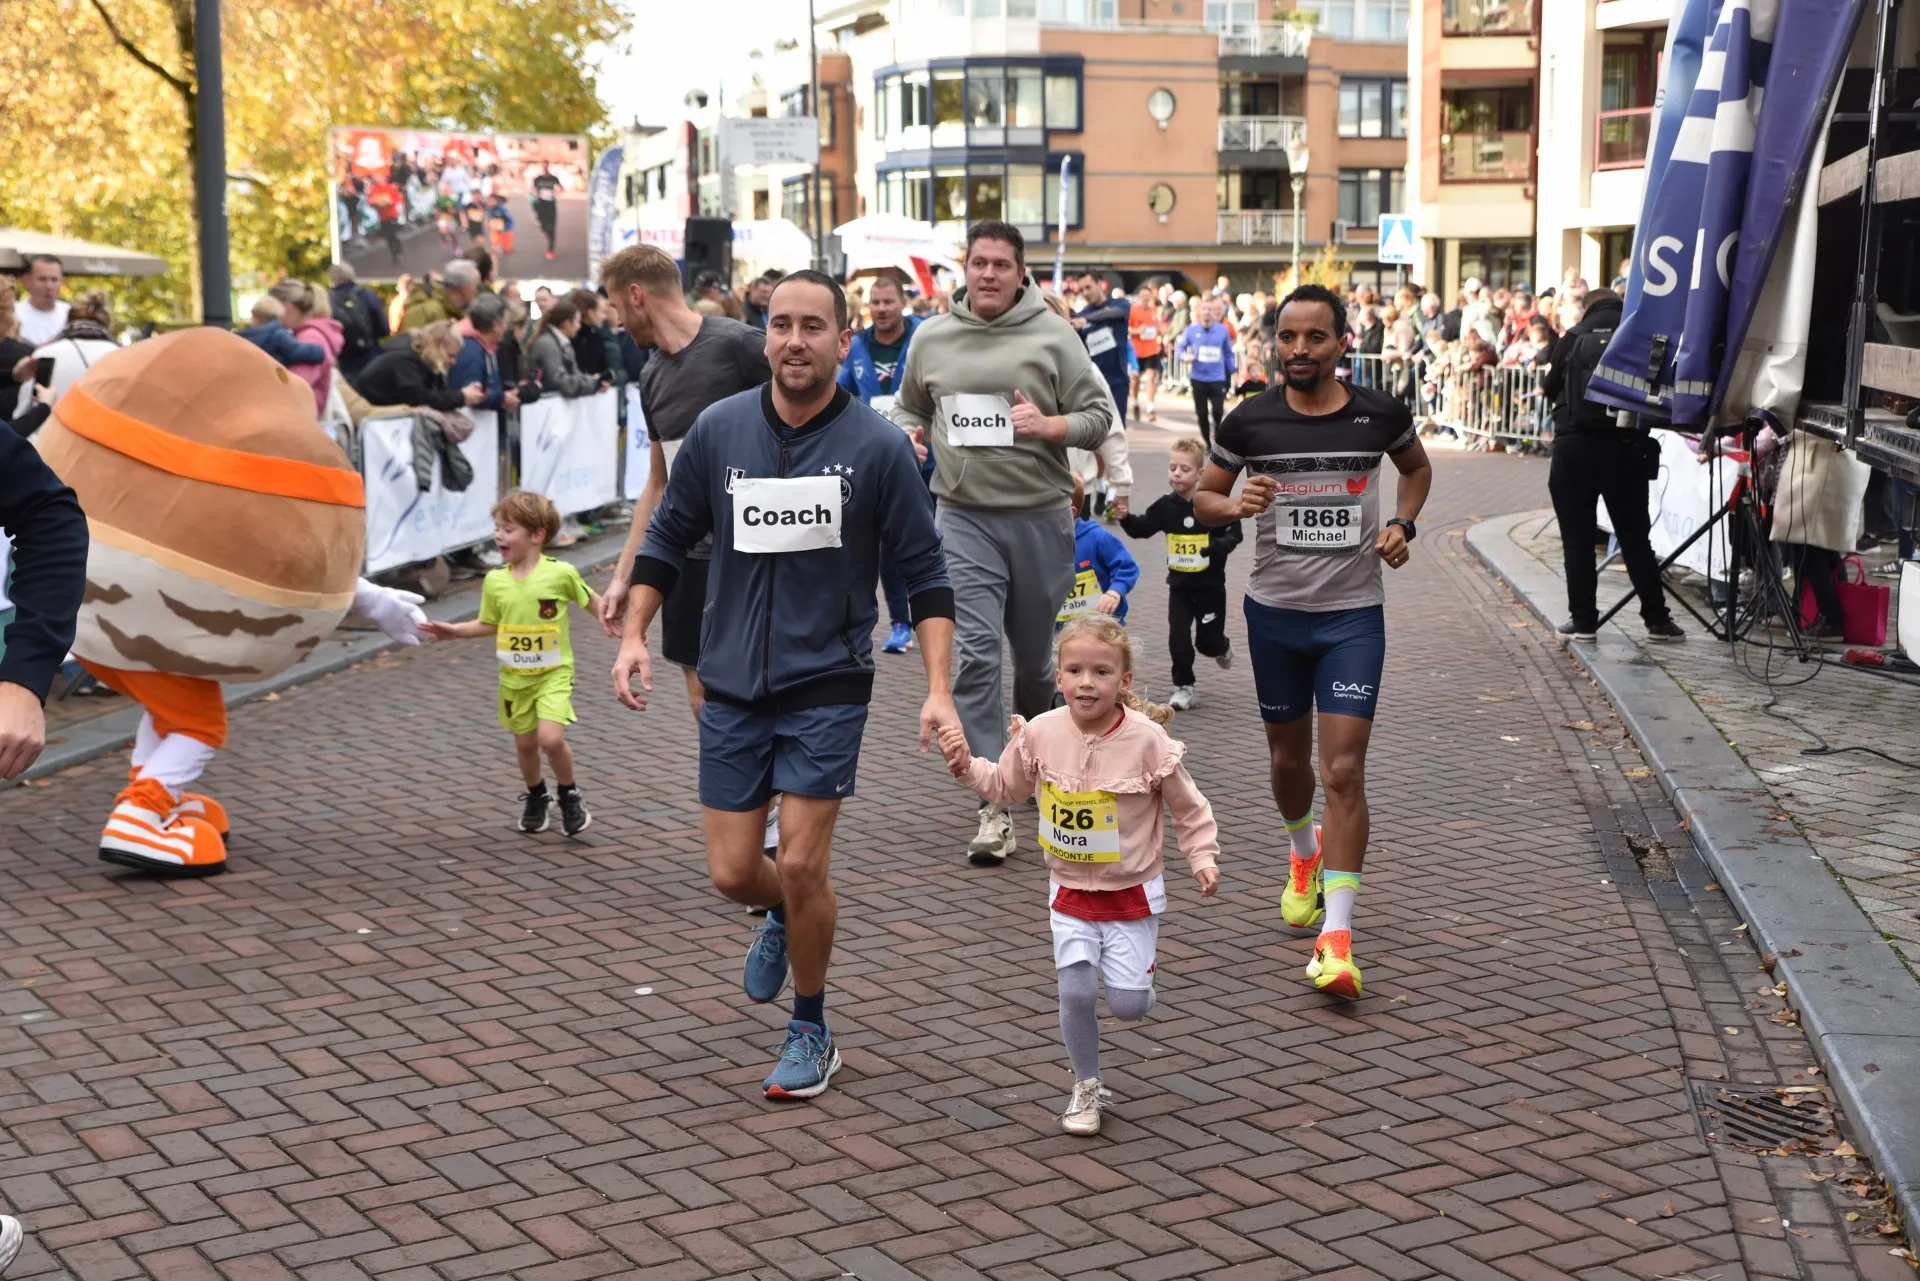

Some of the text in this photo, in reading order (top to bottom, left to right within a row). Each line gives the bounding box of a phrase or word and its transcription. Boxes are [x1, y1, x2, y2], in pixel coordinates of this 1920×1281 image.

[951, 412, 1007, 429] Coach
[1270, 481, 1342, 496] dagium
[742, 504, 832, 527] Coach
[1288, 508, 1350, 527] 1868
[1292, 529, 1346, 541] Michael
[1174, 543, 1197, 555] 213
[509, 636, 543, 651] 291
[513, 653, 543, 663] Duuk
[1050, 802, 1094, 830] 126
[1053, 827, 1088, 846] Nora
[1049, 844, 1094, 862] KROONTJE
